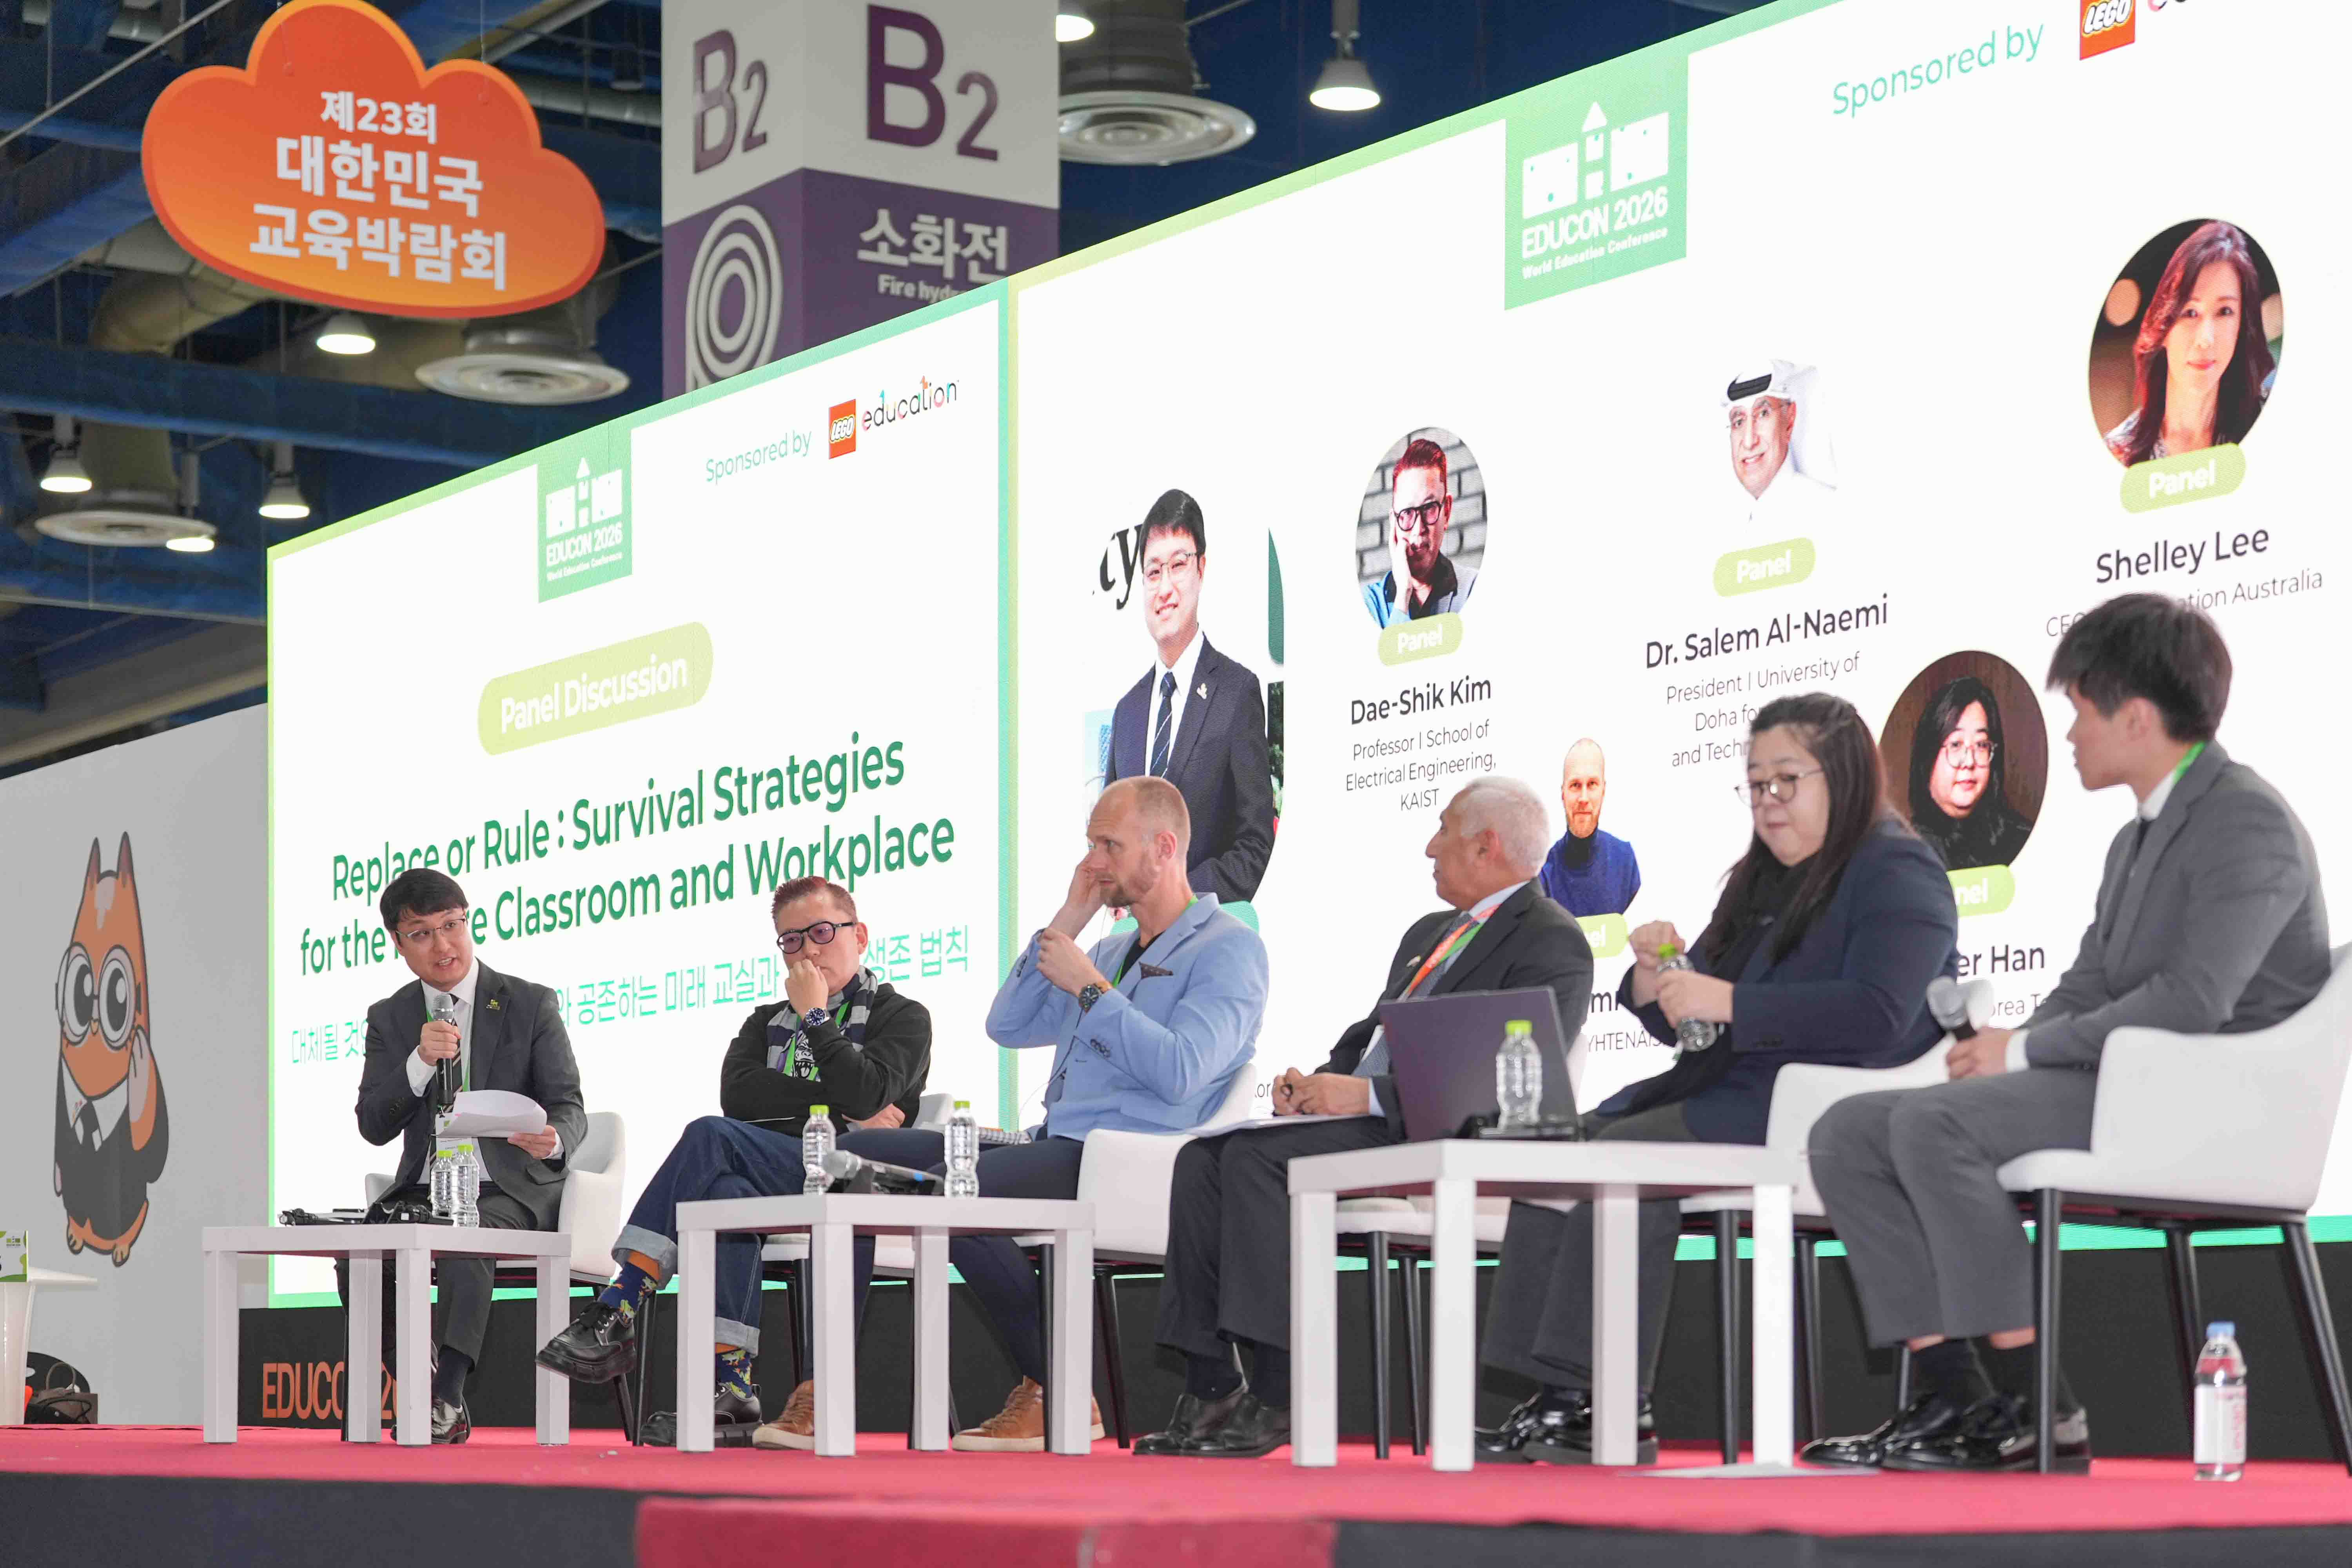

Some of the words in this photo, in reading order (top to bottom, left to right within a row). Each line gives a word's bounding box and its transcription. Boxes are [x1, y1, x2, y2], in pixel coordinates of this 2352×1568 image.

[867, 4, 998, 162] B2
[1833, 30, 1995, 117] Sponsored
[2006, 24, 2043, 62] by
[2083, 0, 2132, 35] LEGO
[321, 91, 437, 144] 제23회
[693, 29, 768, 174] B2
[276, 135, 483, 218] 대한민국
[249, 203, 506, 291] 교육박람회
[857, 208, 1008, 283] 소화전
[1523, 203, 1609, 260] EDUCON
[1613, 185, 1668, 231] 2026
[1522, 260, 1552, 279] World
[1555, 245, 1606, 270] Education
[1608, 227, 1668, 253] Conference
[877, 274, 916, 297] Fire
[706, 432, 787, 485] Sponsored
[793, 430, 811, 457] by
[829, 415, 855, 443] LEGO
[862, 376, 956, 431] education
[2149, 459, 2216, 499] Panel
[546, 531, 592, 567] EDUCON
[594, 521, 623, 551] 2026
[1737, 549, 1791, 583] Panel
[2096, 539, 2206, 583] Shelley
[2215, 528, 2269, 561] Lee
[2232, 568, 2323, 604] Australia
[1398, 623, 1443, 655] Panel
[1647, 641, 1678, 668] Dr.
[1685, 627, 1759, 661] Salem
[1766, 592, 1887, 647] Al-Naemi
[501, 682, 560, 734] Panel
[565, 653, 687, 718] Discussion
[1352, 682, 1444, 725] Dae-Shik
[1451, 675, 1491, 706] Kim
[1667, 675, 1742, 704] President
[1758, 658, 1840, 688] University
[1844, 651, 1860, 672] of
[1354, 738, 1414, 760] Professor
[1427, 722, 1472, 748] School
[1476, 719, 1490, 739] of
[1695, 709, 1737, 731] Doha
[1742, 704, 1759, 723] fo
[1347, 764, 1405, 791] Electrical
[1410, 751, 1496, 782] Engineering,
[1672, 744, 1701, 767] and
[333, 841, 439, 906] Replace
[447, 835, 475, 876] or
[484, 809, 550, 869] Rule
[573, 769, 703, 850] Survival
[713, 731, 904, 821] Strategies
[1401, 788, 1439, 810] KAIST
[301, 928, 335, 976] for
[342, 919, 386, 968] the
[495, 873, 660, 940] Classroom
[671, 844, 733, 909] and
[745, 815, 954, 895] Workplace
[1956, 878, 1988, 904] nel
[1991, 945, 2044, 973] Han
[292, 1023, 338, 1064] 대체될
[577, 975, 657, 1025] 공존하는
[666, 965, 705, 1011] 미래
[713, 955, 779, 1004] 교실과
[864, 935, 911, 982] 생존
[920, 925, 967, 977] 법칙
[263, 1361, 345, 1419] EDUCO
